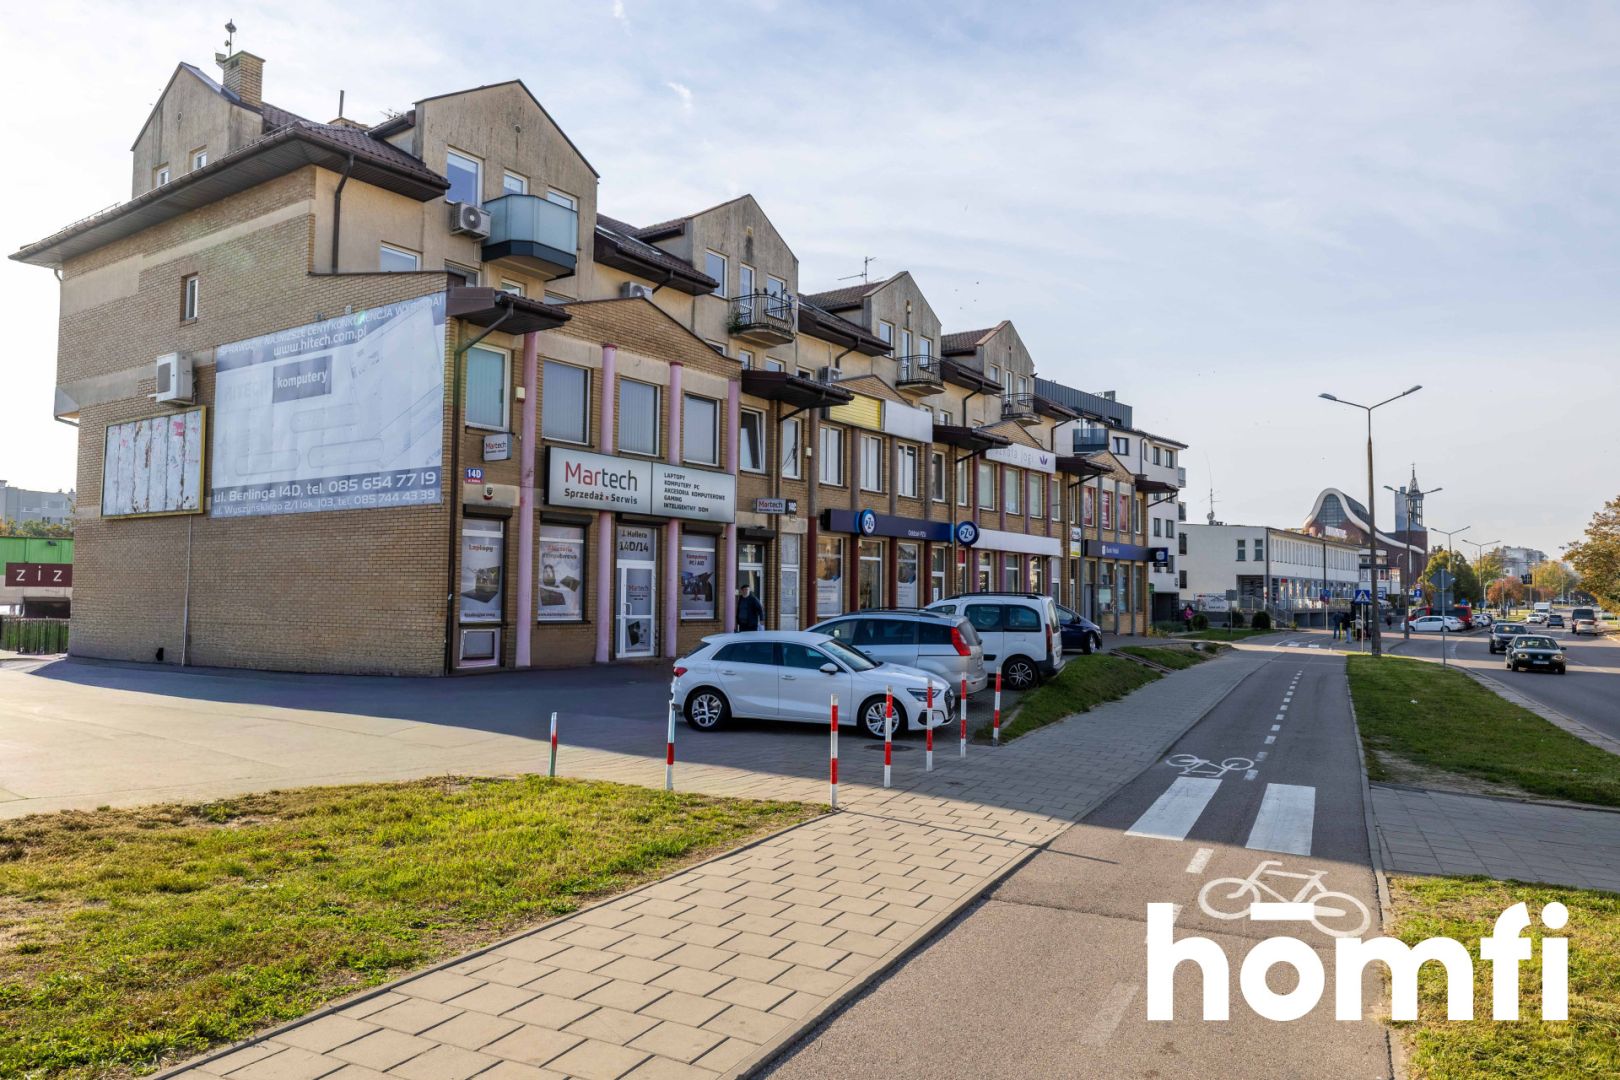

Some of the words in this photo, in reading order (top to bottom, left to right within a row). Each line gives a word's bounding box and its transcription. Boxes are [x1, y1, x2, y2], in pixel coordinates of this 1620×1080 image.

[273, 325, 367, 356] www.hitech.com.pl
[277, 370, 328, 388] komputery
[467, 469, 482, 478] 14D
[565, 461, 638, 492] Martech
[664, 472, 686, 480] LAPTOPY
[214, 491, 226, 503] ul.
[229, 489, 276, 502] Berlinga
[306, 482, 325, 495] tel.
[328, 479, 358, 493] 085
[362, 476, 393, 490] 654
[396, 473, 417, 488] 77
[421, 471, 437, 485] 19
[664, 480, 691, 488] KOMPUTERY
[354, 494, 376, 505] 085
[379, 492, 399, 503] 744
[402, 490, 418, 501] 43
[420, 489, 436, 500] 39
[564, 487, 604, 502] Sprzedaż
[610, 493, 638, 505] Serwis
[664, 487, 690, 496] AKCESORIA
[691, 491, 726, 501] KOMPUTEROWE
[758, 501, 783, 509] Martech
[864, 517, 874, 530] PZU
[627, 529, 647, 539] Hallera
[960, 528, 973, 539] PZU
[468, 543, 494, 553] Laptopy
[619, 541, 649, 552] 14D/14
